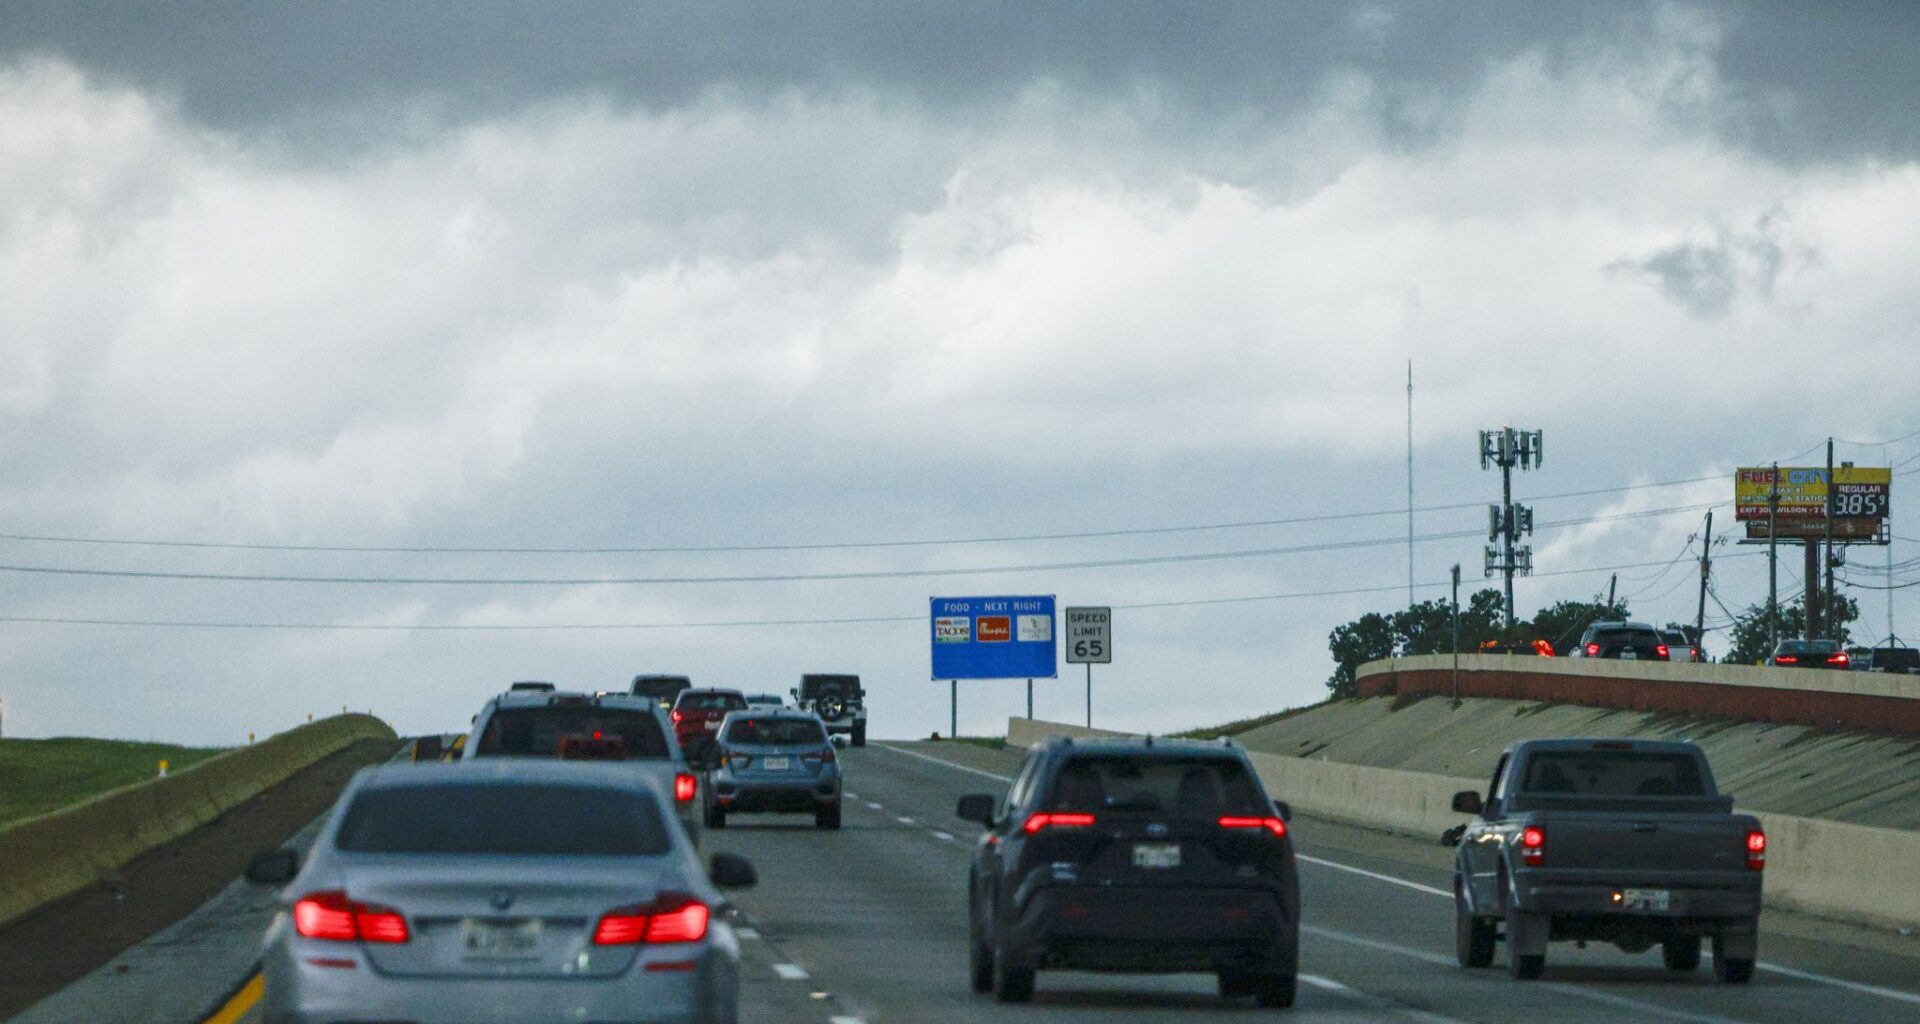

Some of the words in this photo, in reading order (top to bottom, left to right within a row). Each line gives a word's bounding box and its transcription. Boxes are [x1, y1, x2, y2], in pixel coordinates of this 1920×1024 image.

[1838, 485, 1881, 493] REGULAR
[1879, 494, 1886, 506] 9
[1776, 506, 1807, 514] WILSON
[944, 603, 970, 612] FOOD
[984, 602, 1009, 612] NEXT
[1014, 601, 1041, 611] RIGHT
[1070, 613, 1107, 623] SPEED
[1073, 627, 1102, 636] LIMIT
[1074, 640, 1103, 657] 65
